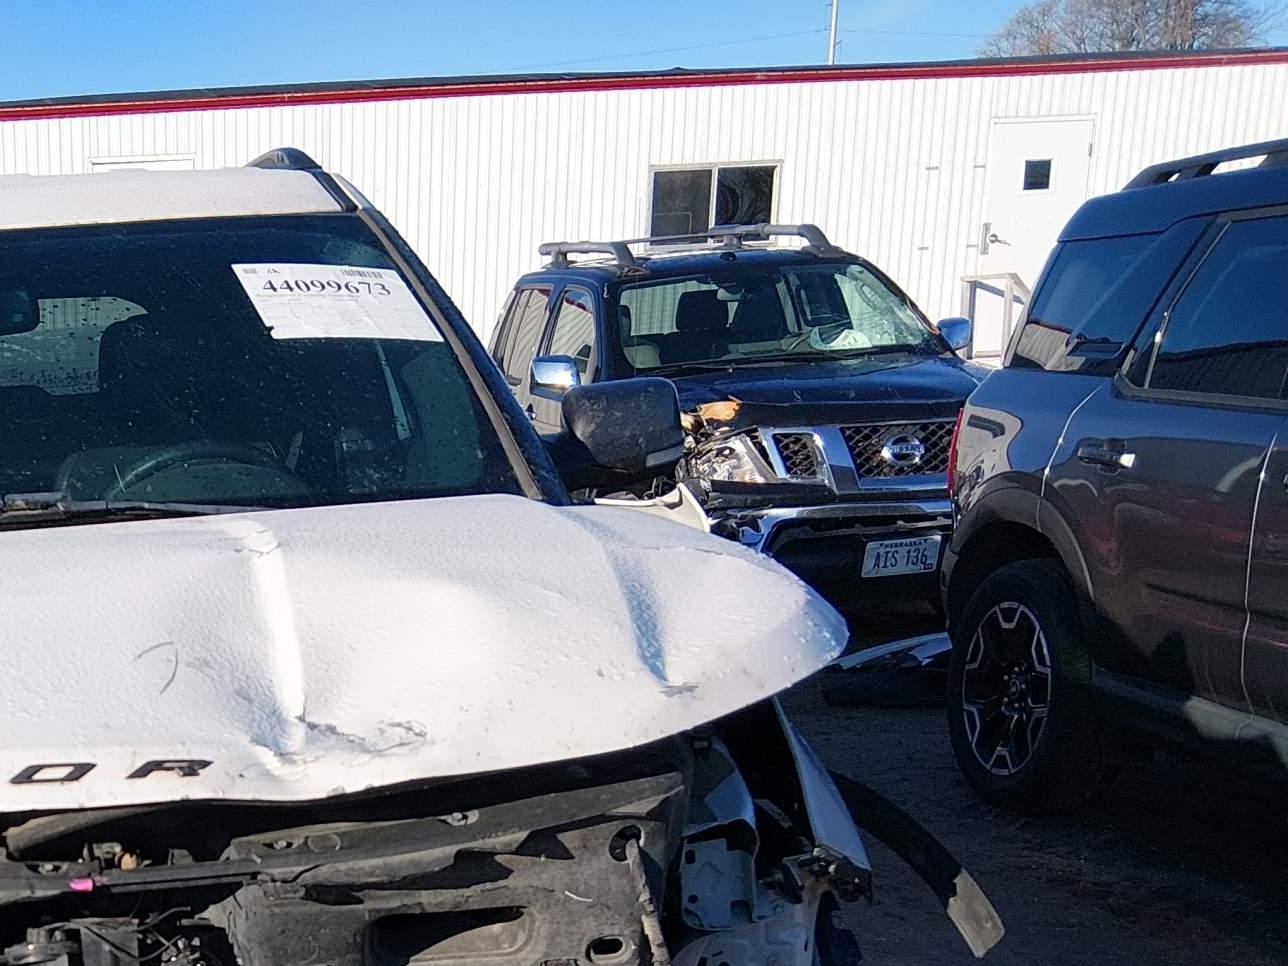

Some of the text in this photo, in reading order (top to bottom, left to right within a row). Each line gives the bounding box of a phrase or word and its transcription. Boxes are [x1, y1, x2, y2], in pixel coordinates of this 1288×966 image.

[262, 279, 392, 296] 44099673
[873, 547, 928, 569] AIS 136
